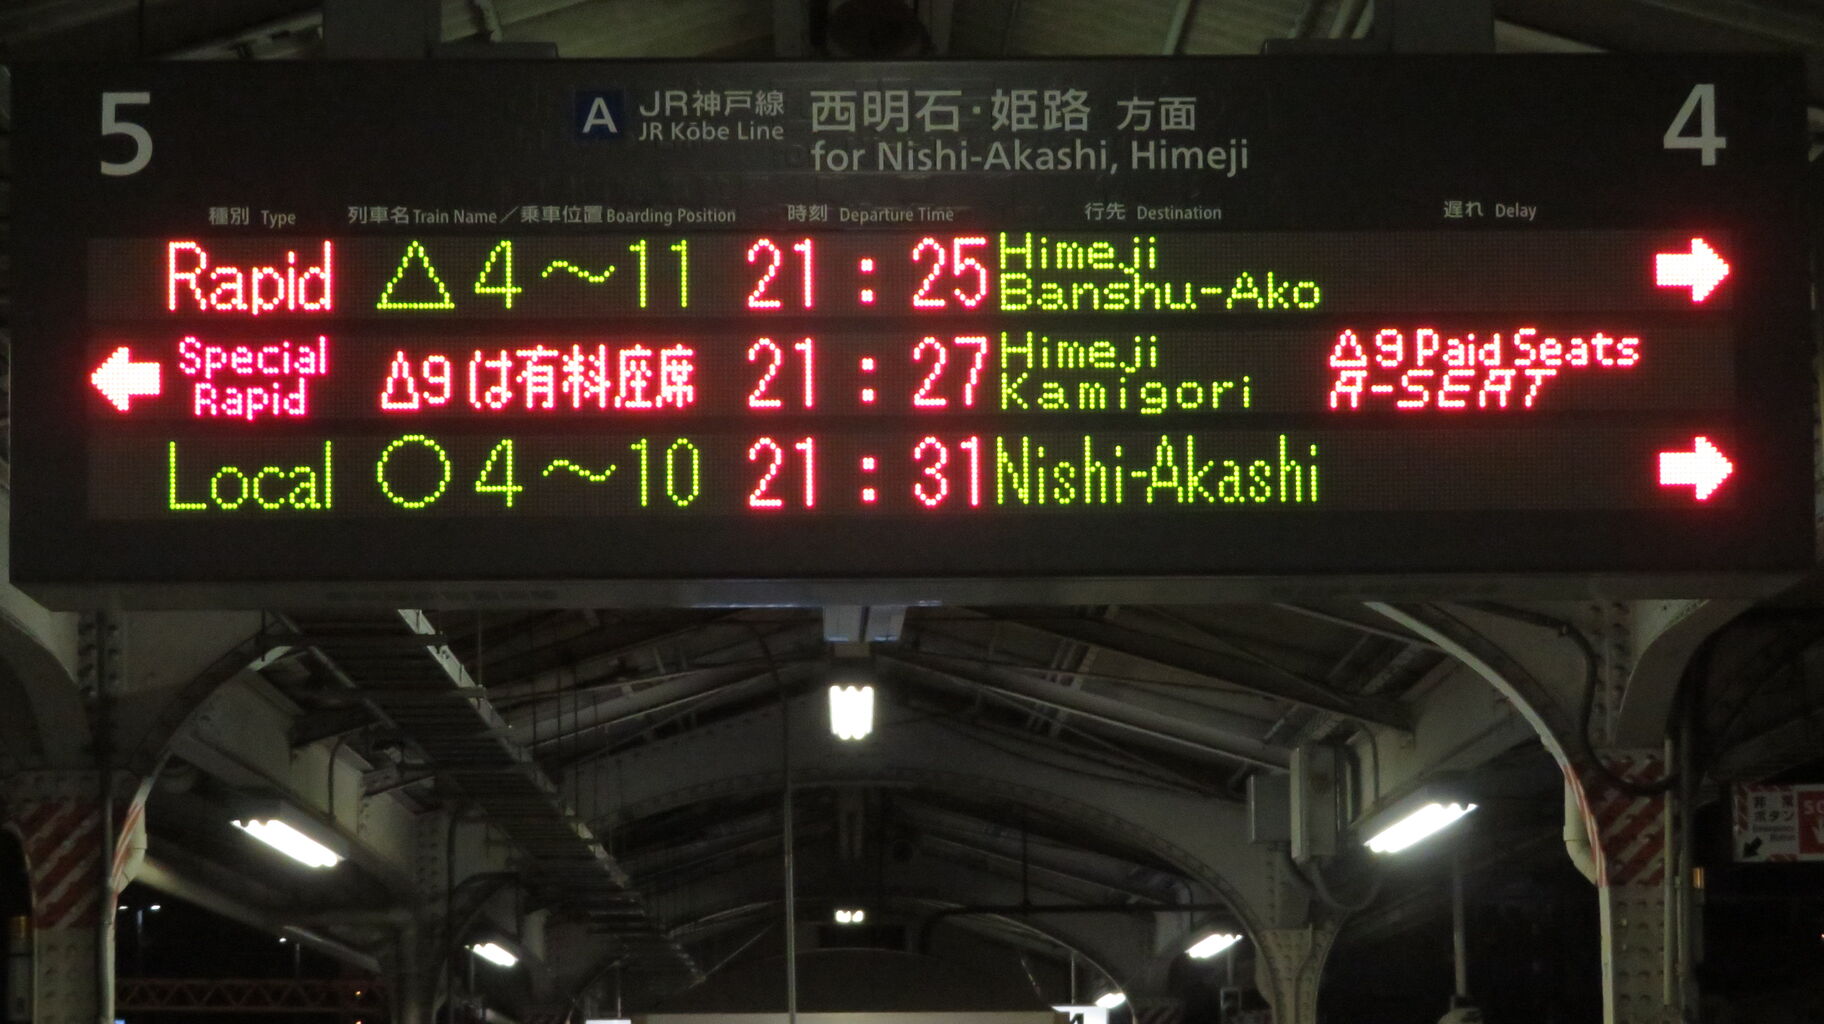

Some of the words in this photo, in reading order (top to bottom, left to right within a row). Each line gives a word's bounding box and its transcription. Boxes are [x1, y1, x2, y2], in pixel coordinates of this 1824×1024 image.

[583, 98, 617, 132] A
[640, 90, 784, 117] JR神戸線
[1117, 97, 1197, 132] 方面
[101, 92, 152, 176] 5
[639, 122, 663, 141] JR
[672, 121, 729, 140] Kōbe
[738, 121, 784, 140] Line
[1664, 84, 1727, 166] 4
[811, 140, 866, 171] for
[879, 139, 1118, 174] Nishi-Akashi,
[1132, 139, 1248, 177] Himeji
[208, 207, 249, 225] 種別
[261, 210, 296, 228] Type
[348, 206, 409, 224] 列車名
[413, 209, 449, 224] Train
[454, 210, 497, 224] Name
[606, 208, 673, 226] Boarding
[678, 208, 736, 223] Position
[787, 204, 828, 222] 時刻
[839, 207, 913, 225] Departure
[918, 207, 954, 222] Time
[1085, 203, 1126, 220] 行先
[1137, 205, 1222, 220] Destination
[1443, 201, 1484, 218] 遅れ
[1495, 203, 1537, 221] Delay
[1000, 232, 1156, 272] Himeji
[168, 240, 333, 315] Rapid
[1000, 272, 1320, 311] Banshu-Ako
[178, 335, 329, 379] Special
[1001, 332, 1157, 373] Himeji
[1414, 328, 1501, 367] Paid
[1513, 327, 1641, 366] Seats
[193, 379, 308, 420] Rapid
[1001, 373, 1250, 414] Kamigori
[1328, 369, 1560, 410] A-SEAT
[169, 440, 332, 510] Local
[996, 434, 1317, 505] Nishi-Akashi
